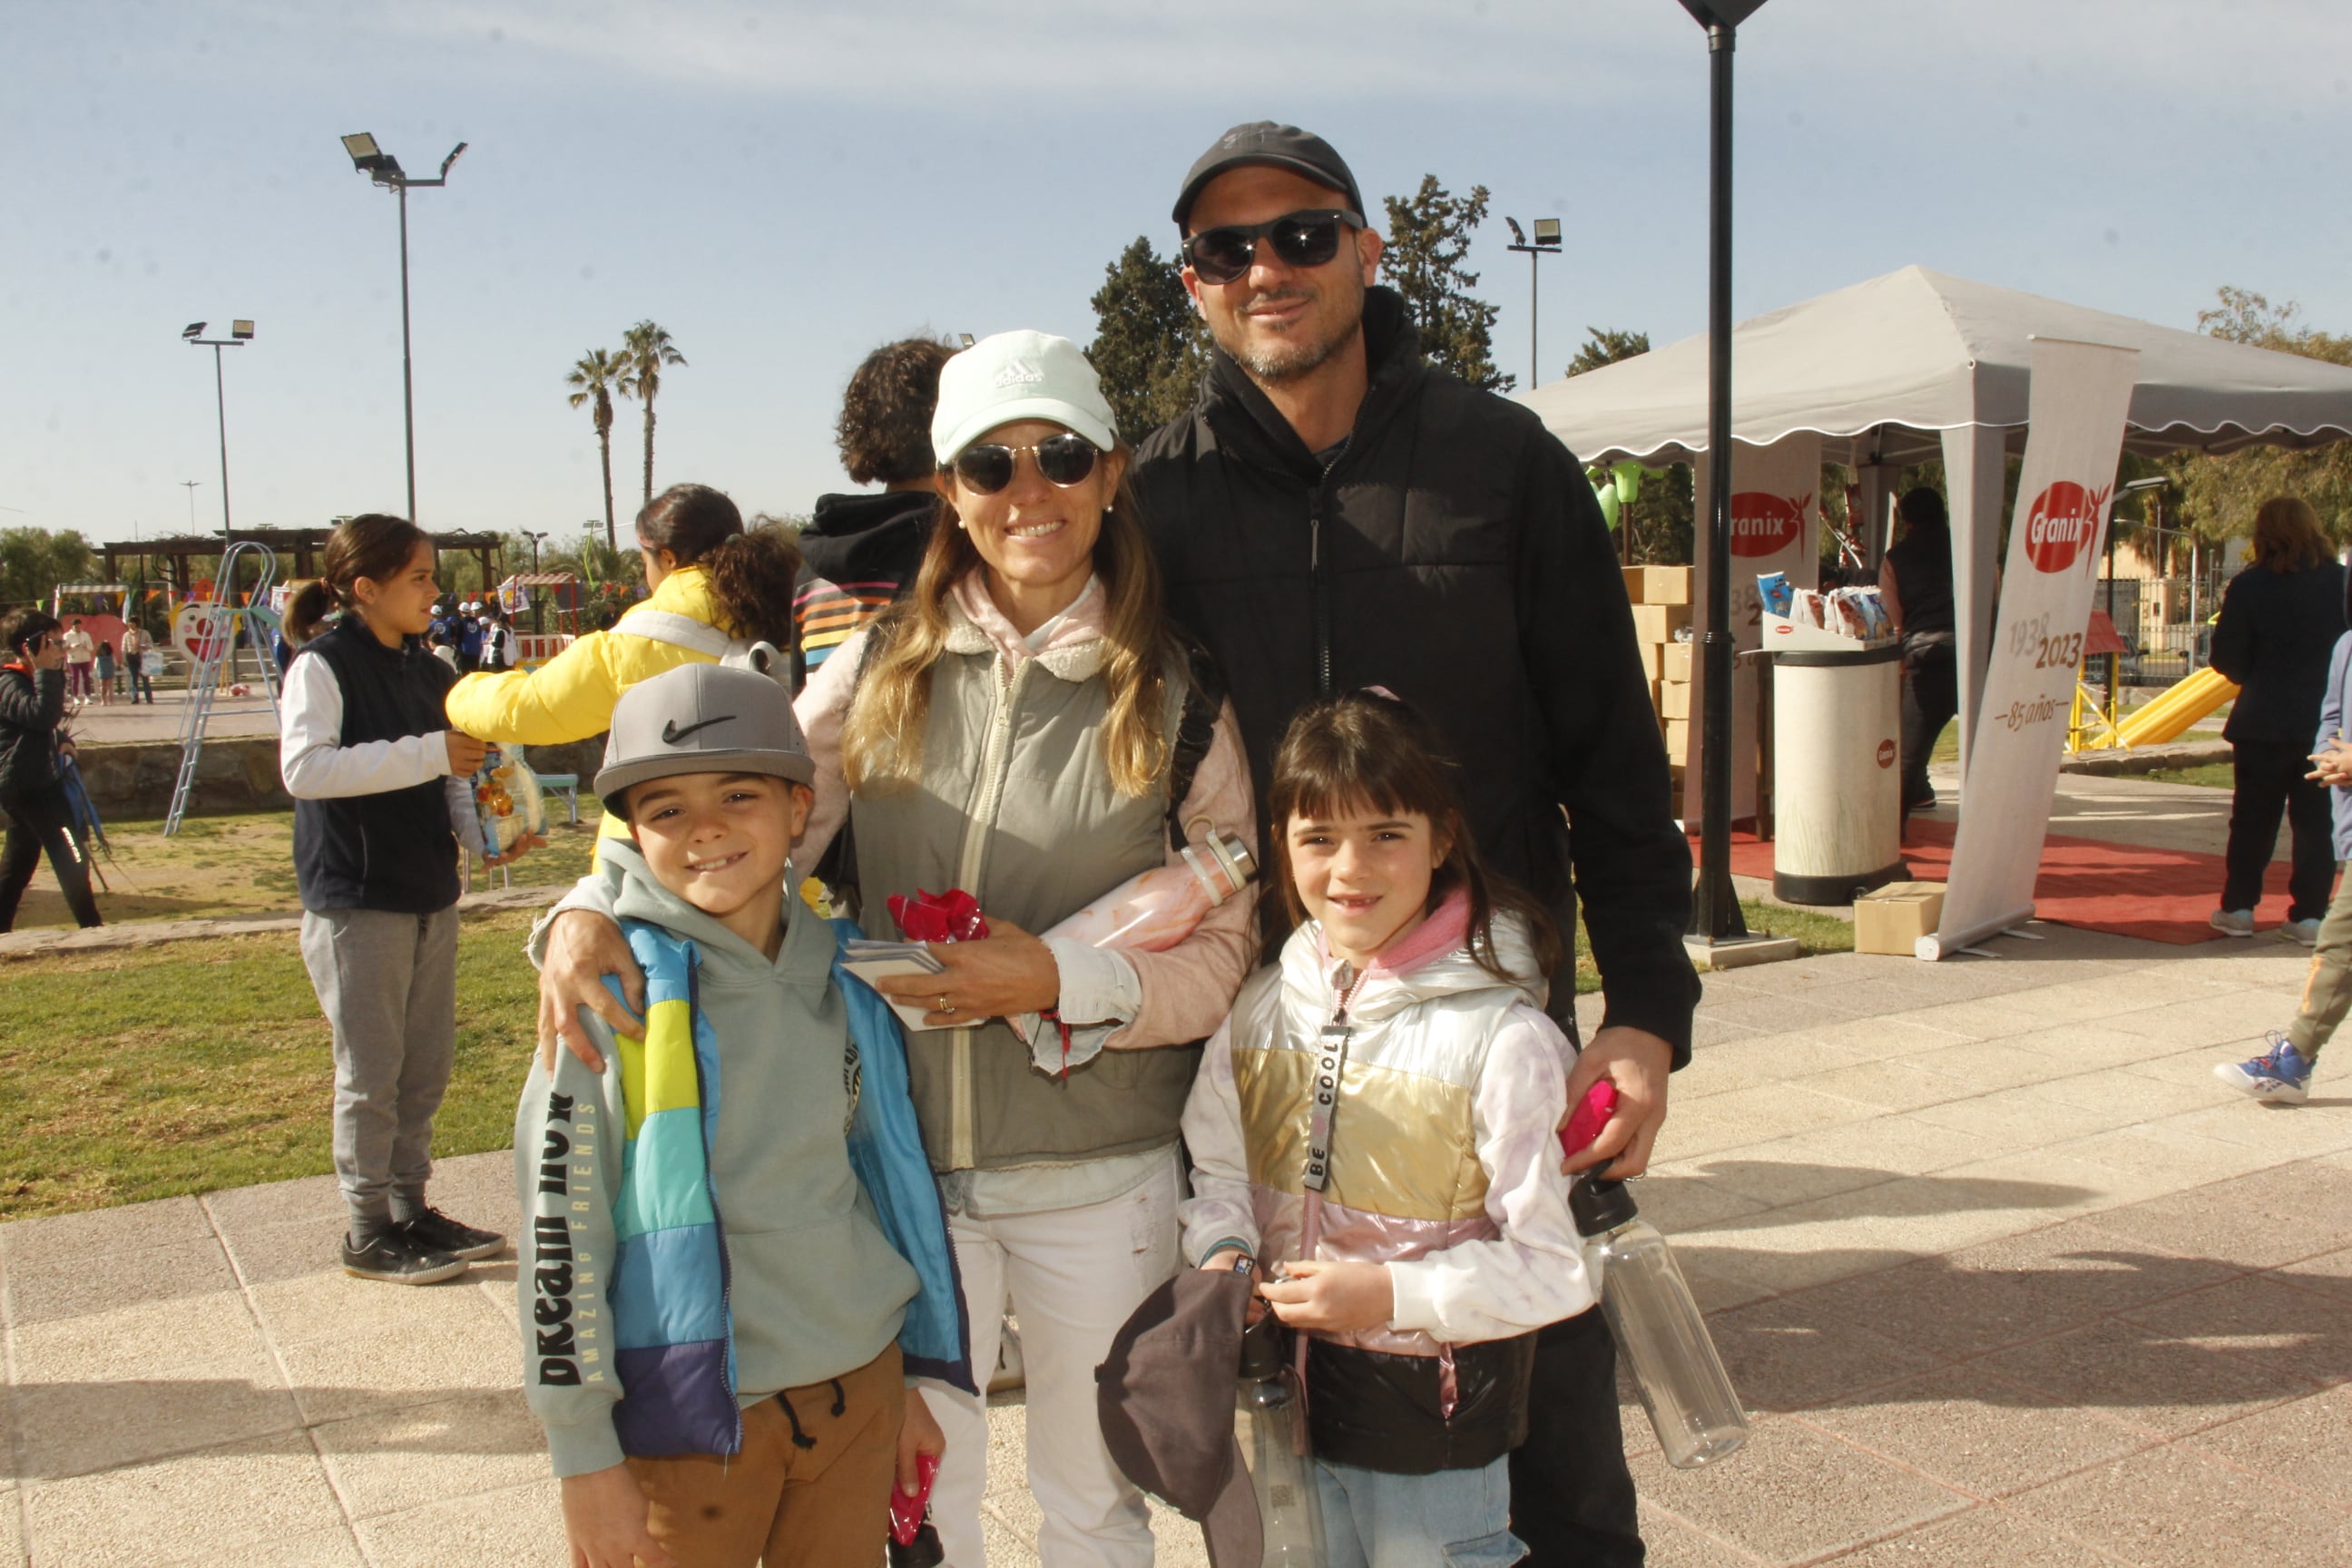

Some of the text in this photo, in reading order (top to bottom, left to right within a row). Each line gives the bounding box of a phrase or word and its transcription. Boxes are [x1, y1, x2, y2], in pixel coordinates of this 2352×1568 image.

[1730, 510, 1785, 536] ranix
[2031, 507, 2082, 544] Granix
[2010, 612, 2051, 659] 1938
[2034, 632, 2082, 670] 2023
[1308, 1043, 1339, 1177] BE COOL
[571, 1102, 605, 1383] AMAZING FRIENDS
